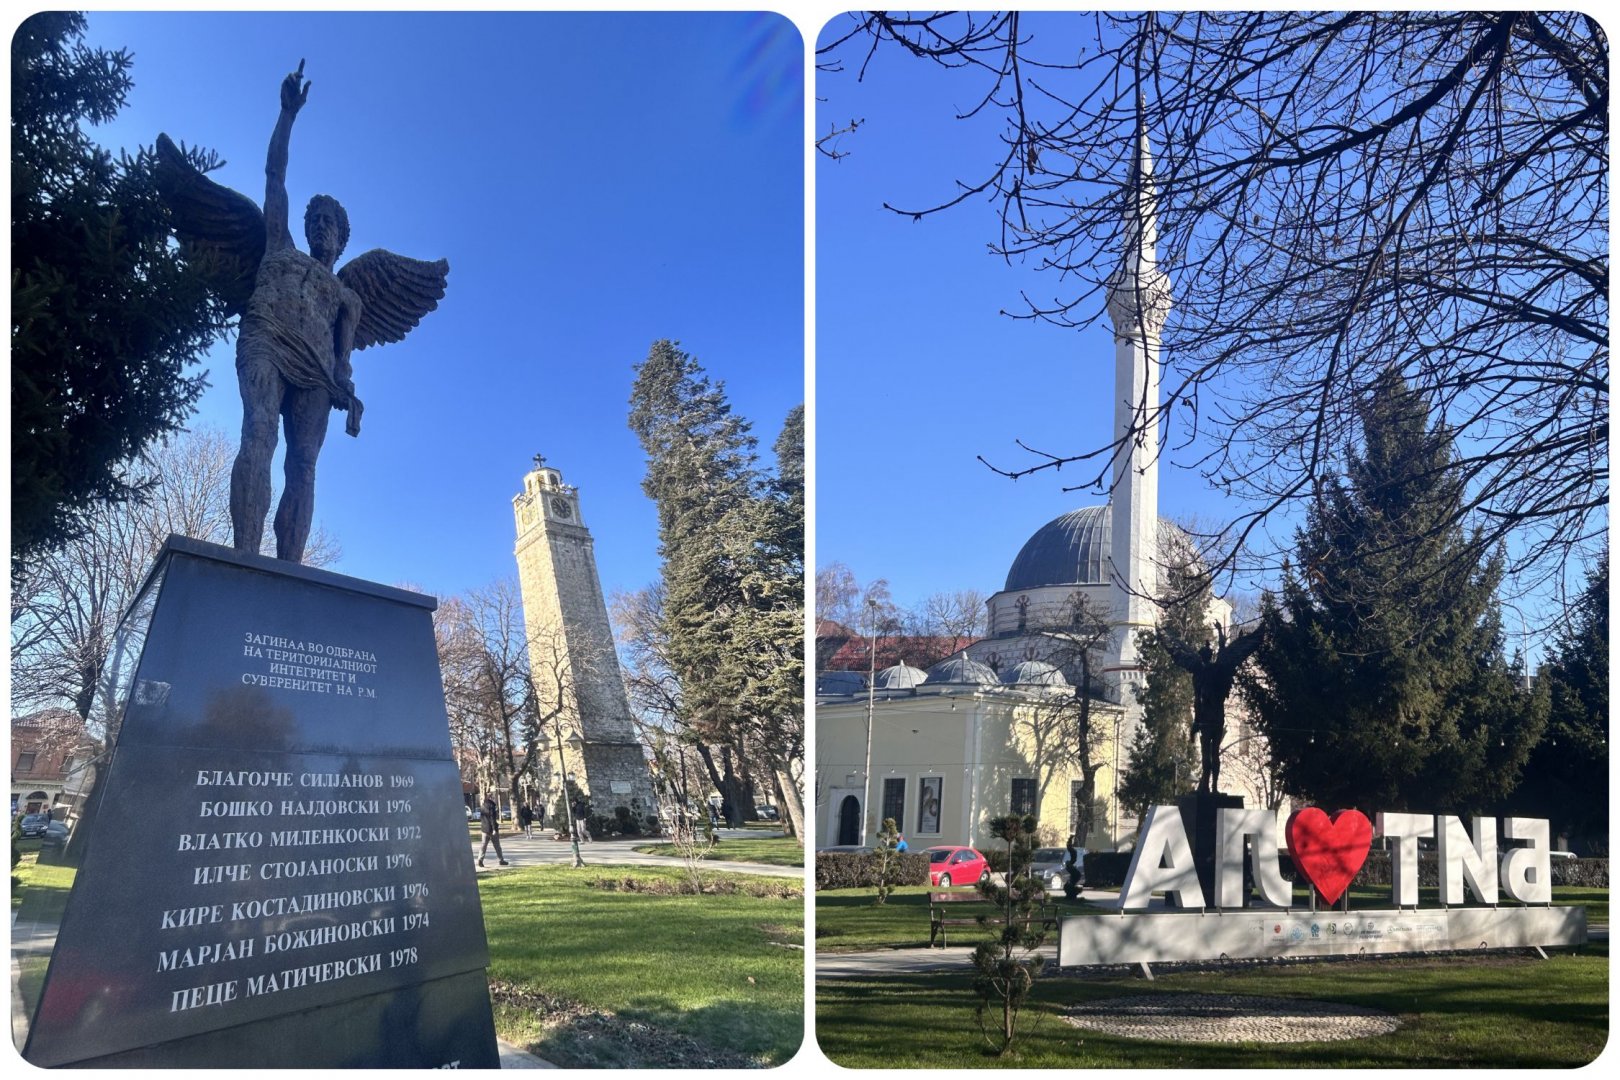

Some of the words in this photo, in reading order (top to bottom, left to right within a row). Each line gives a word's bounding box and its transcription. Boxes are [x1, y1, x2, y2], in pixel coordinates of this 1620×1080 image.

[244, 646, 263, 658] НА
[266, 648, 377, 674] ТЕРИТОРИЈАЛНИОТ
[245, 632, 305, 651] ЗАГИНАА
[308, 643, 324, 653] ВО
[326, 646, 377, 662] ОДБРАНА
[242, 673, 332, 693] СУВЕРЕНИТЕТ
[337, 685, 353, 696] НА
[269, 663, 346, 682] ИНТЕГРИТЕТ
[348, 673, 356, 683] И
[196, 770, 293, 787] БЛАГОЈЧЕ
[300, 773, 383, 788] СИЛЈАНОВ
[390, 775, 414, 788] 1969
[200, 801, 273, 817] БОШКО
[281, 800, 379, 817] НАЈДОВСКИ
[386, 800, 412, 813] 1976
[178, 831, 263, 851] ВЛАТКО
[270, 827, 389, 847] МИЛЕНКОСКИ
[396, 826, 422, 841] 1972
[193, 864, 251, 885] ИЛЧЕ
[260, 855, 378, 880] СТОЈАНОСКИ
[386, 854, 412, 870] 1976
[161, 905, 224, 930] КИРЕ
[231, 886, 396, 921] КОСТАДИНОВСКИ
[403, 883, 429, 900] 1976
[156, 938, 254, 973] МАРЈАН
[264, 917, 396, 955] БОЖИНОВСКИ
[402, 912, 430, 931] 1974
[170, 980, 238, 1013] ПЕЦЕ
[245, 953, 382, 998] МАТИЧЕВСКИ
[388, 946, 418, 969] 1978
